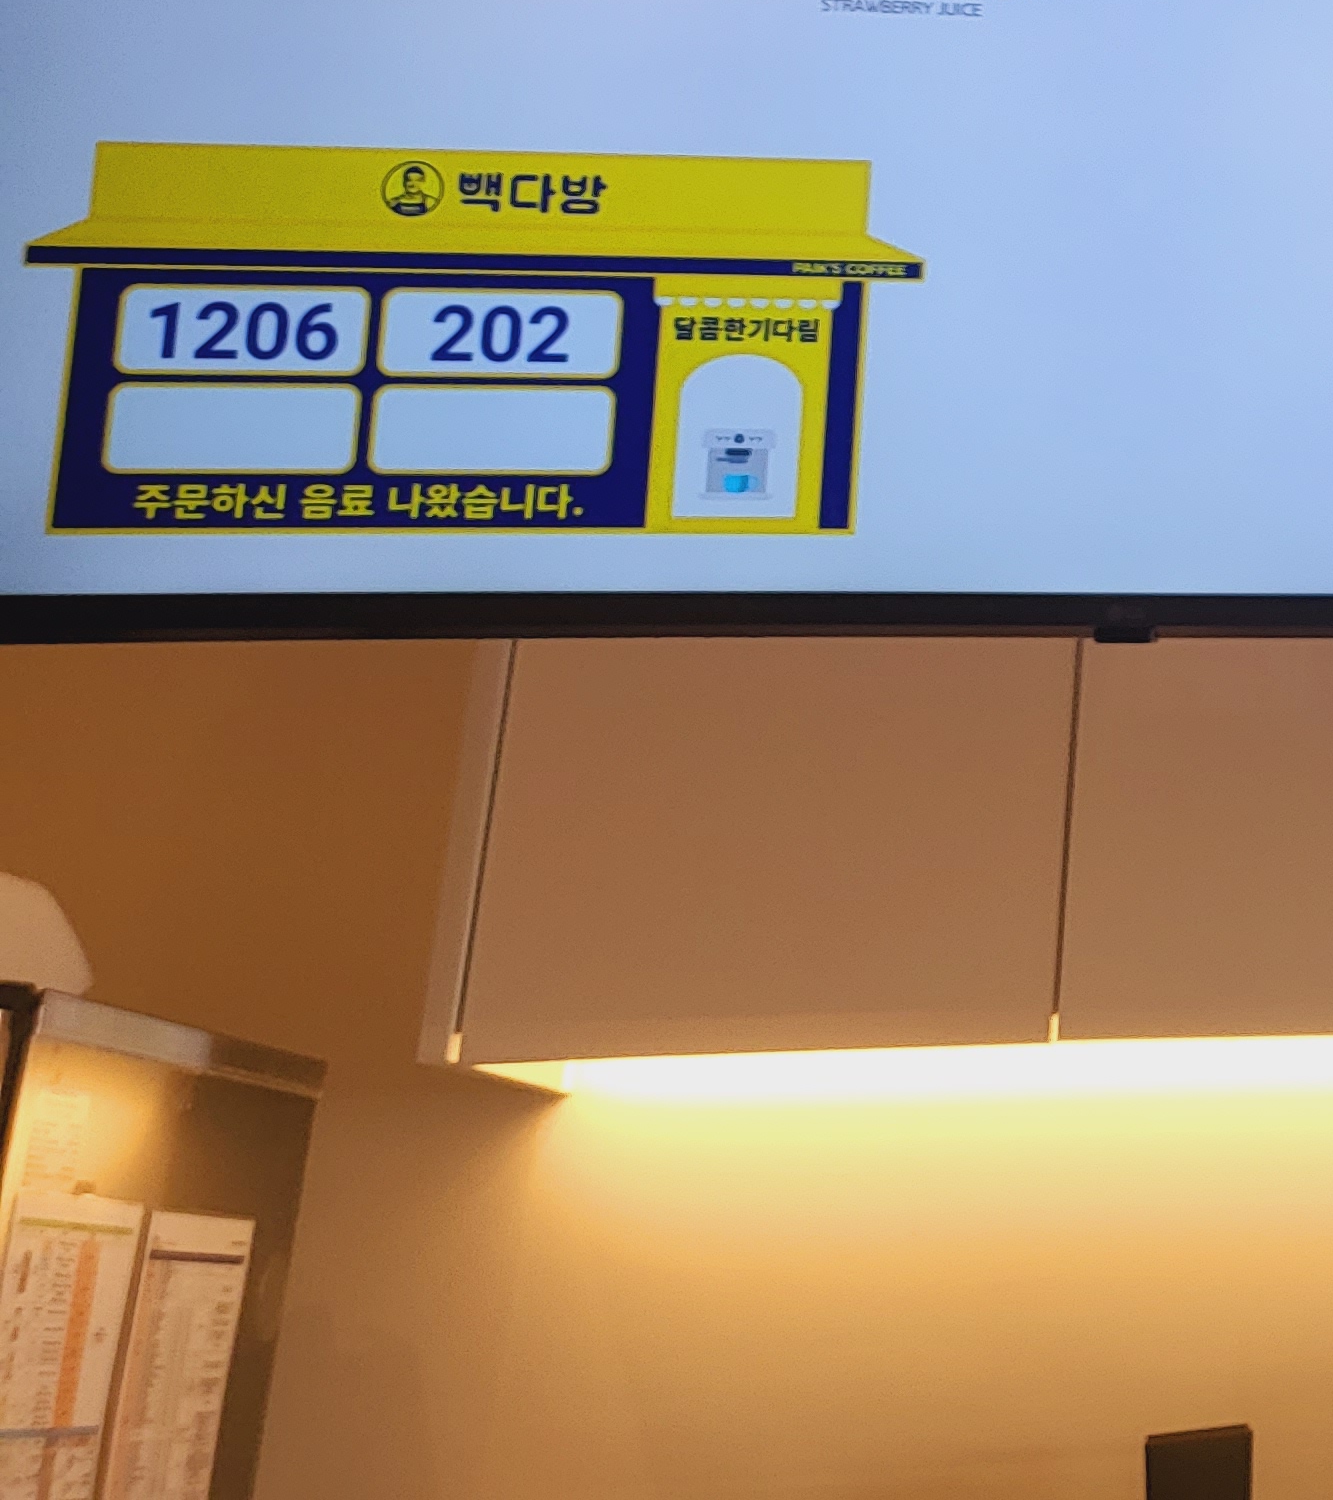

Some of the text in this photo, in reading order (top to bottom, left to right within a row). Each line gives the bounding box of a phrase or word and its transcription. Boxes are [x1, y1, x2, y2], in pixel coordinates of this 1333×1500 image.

[149, 301, 339, 363] 1206
[430, 305, 570, 363] 202
[674, 317, 820, 343] 달콤한기다림
[133, 485, 584, 522] 주문하신 음료 나왔습니다.
